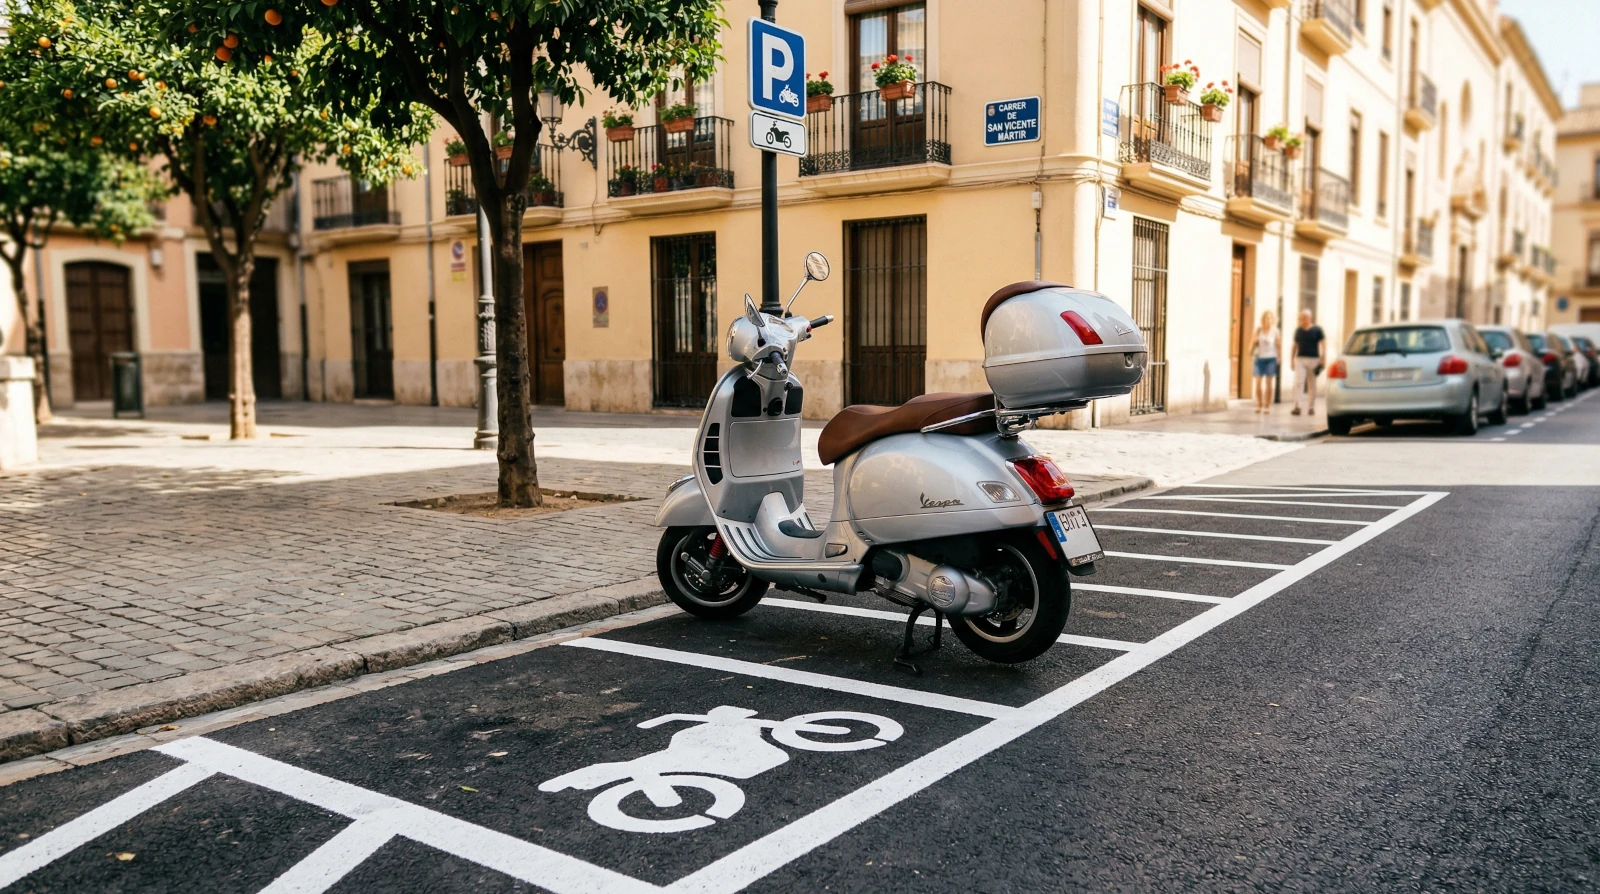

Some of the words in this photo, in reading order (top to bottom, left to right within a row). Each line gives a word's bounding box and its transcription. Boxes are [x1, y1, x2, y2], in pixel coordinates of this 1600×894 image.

[762, 32, 794, 100] P
[999, 102, 1026, 111] CARRER
[988, 123, 1003, 132] SAN
[1004, 119, 1036, 130] VICENTE
[920, 492, 964, 508] Vespa
